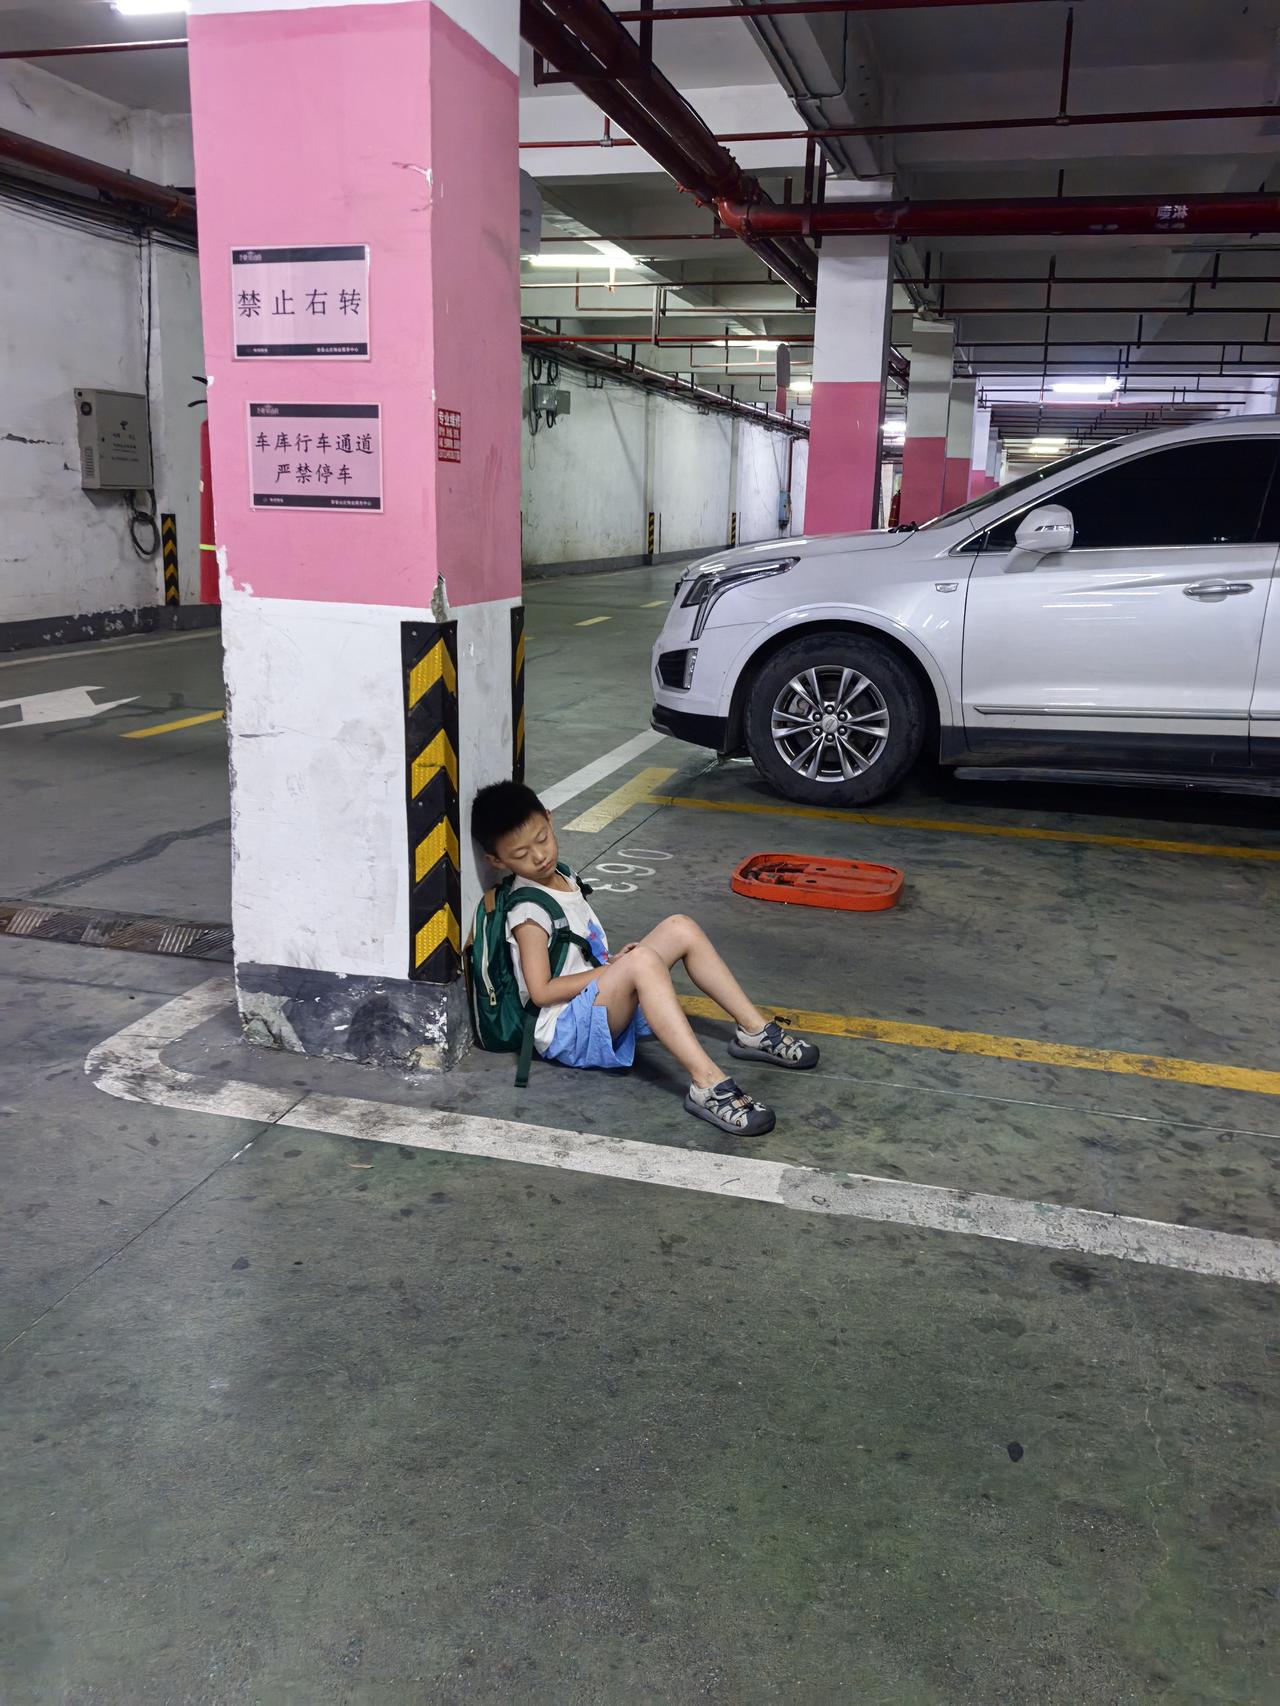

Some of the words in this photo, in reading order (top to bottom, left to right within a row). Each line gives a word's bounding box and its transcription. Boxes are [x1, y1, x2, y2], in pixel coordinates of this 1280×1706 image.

[1156, 204, 1189, 219] 喷淋
[237, 288, 361, 318] 禁止右转
[255, 431, 374, 454] 车库行车通道
[274, 462, 353, 486] 严禁停车
